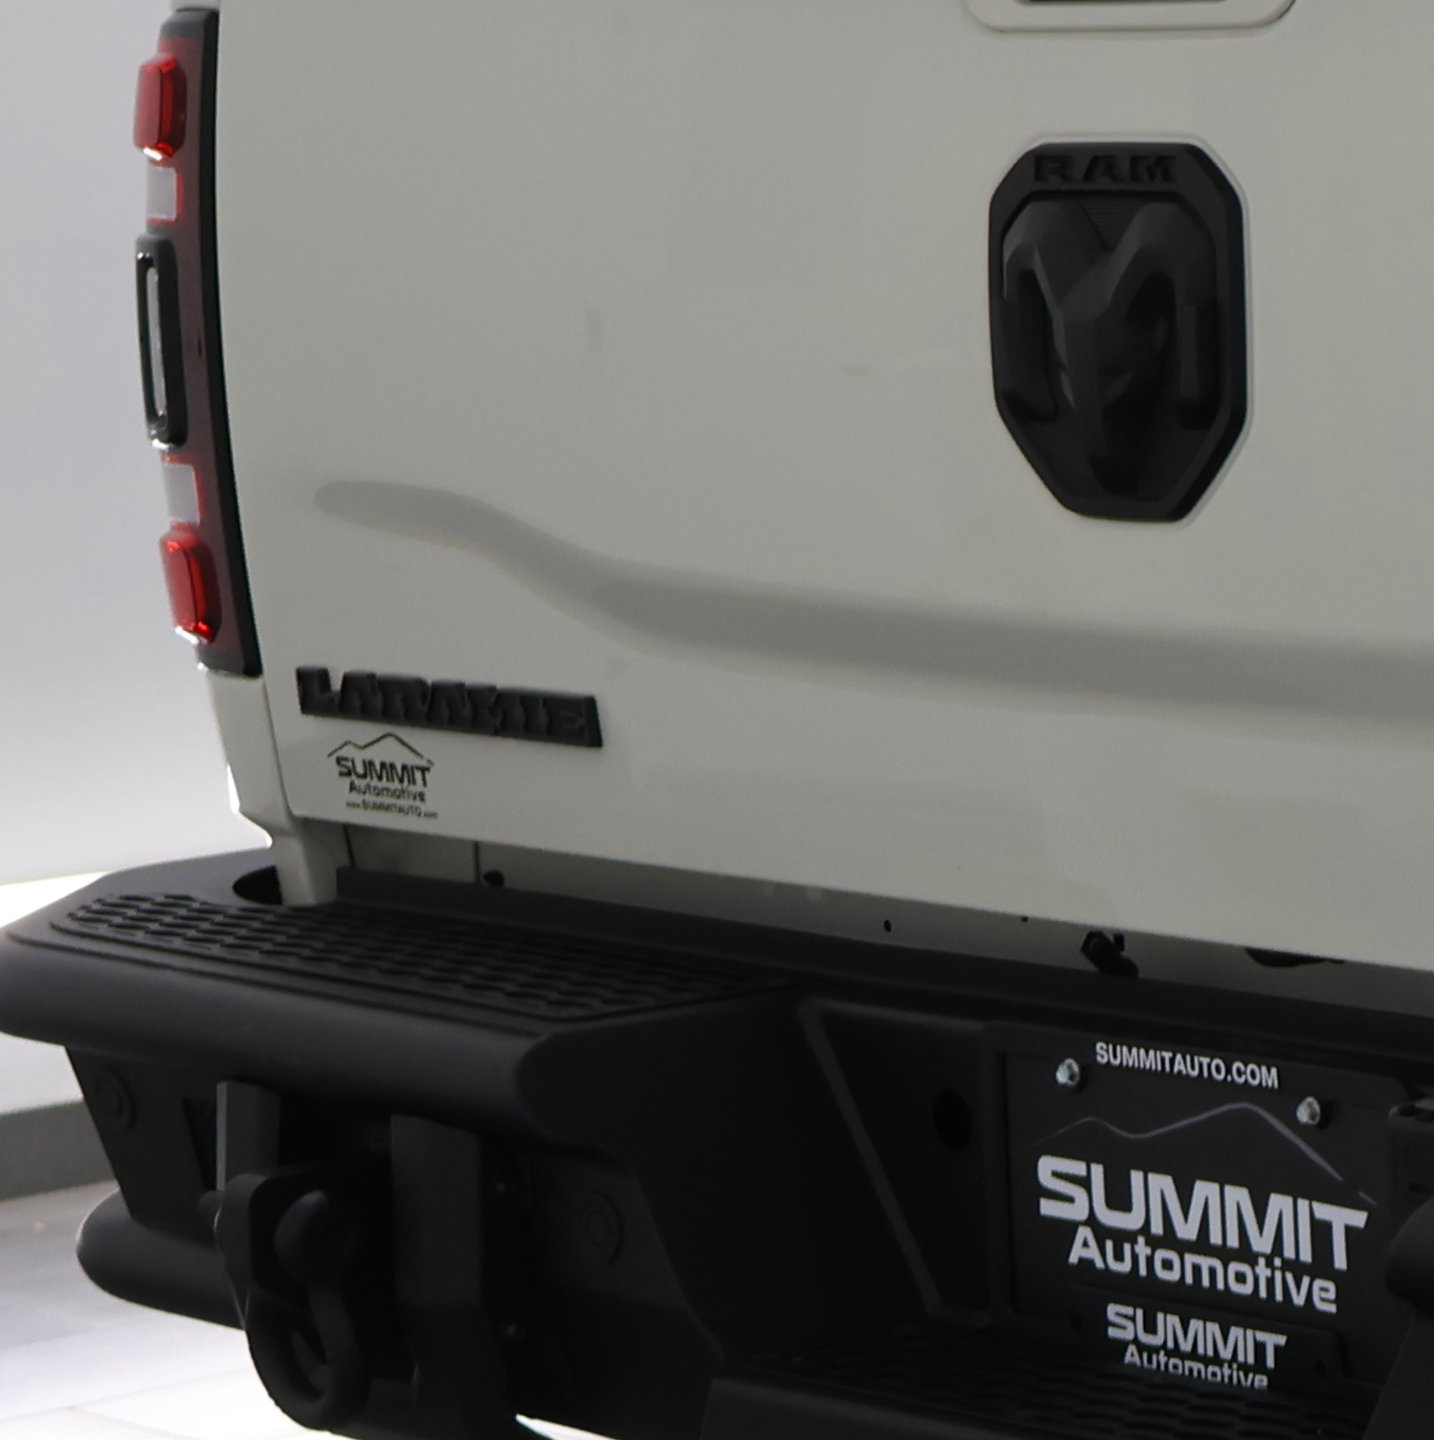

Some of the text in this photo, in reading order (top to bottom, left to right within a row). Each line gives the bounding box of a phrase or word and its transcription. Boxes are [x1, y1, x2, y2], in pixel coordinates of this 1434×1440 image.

[1034, 154, 1177, 184] RAM
[335, 755, 432, 788] SUMMIT
[348, 779, 426, 803] Automotive
[1095, 1041, 1280, 1090] SUMMITAUTO.COM
[1037, 1154, 1369, 1272] SUMMIT
[1067, 1224, 1338, 1314] Automotive
[1106, 1302, 1288, 1370] SUMMIT
[1123, 1343, 1269, 1392] Automotive
